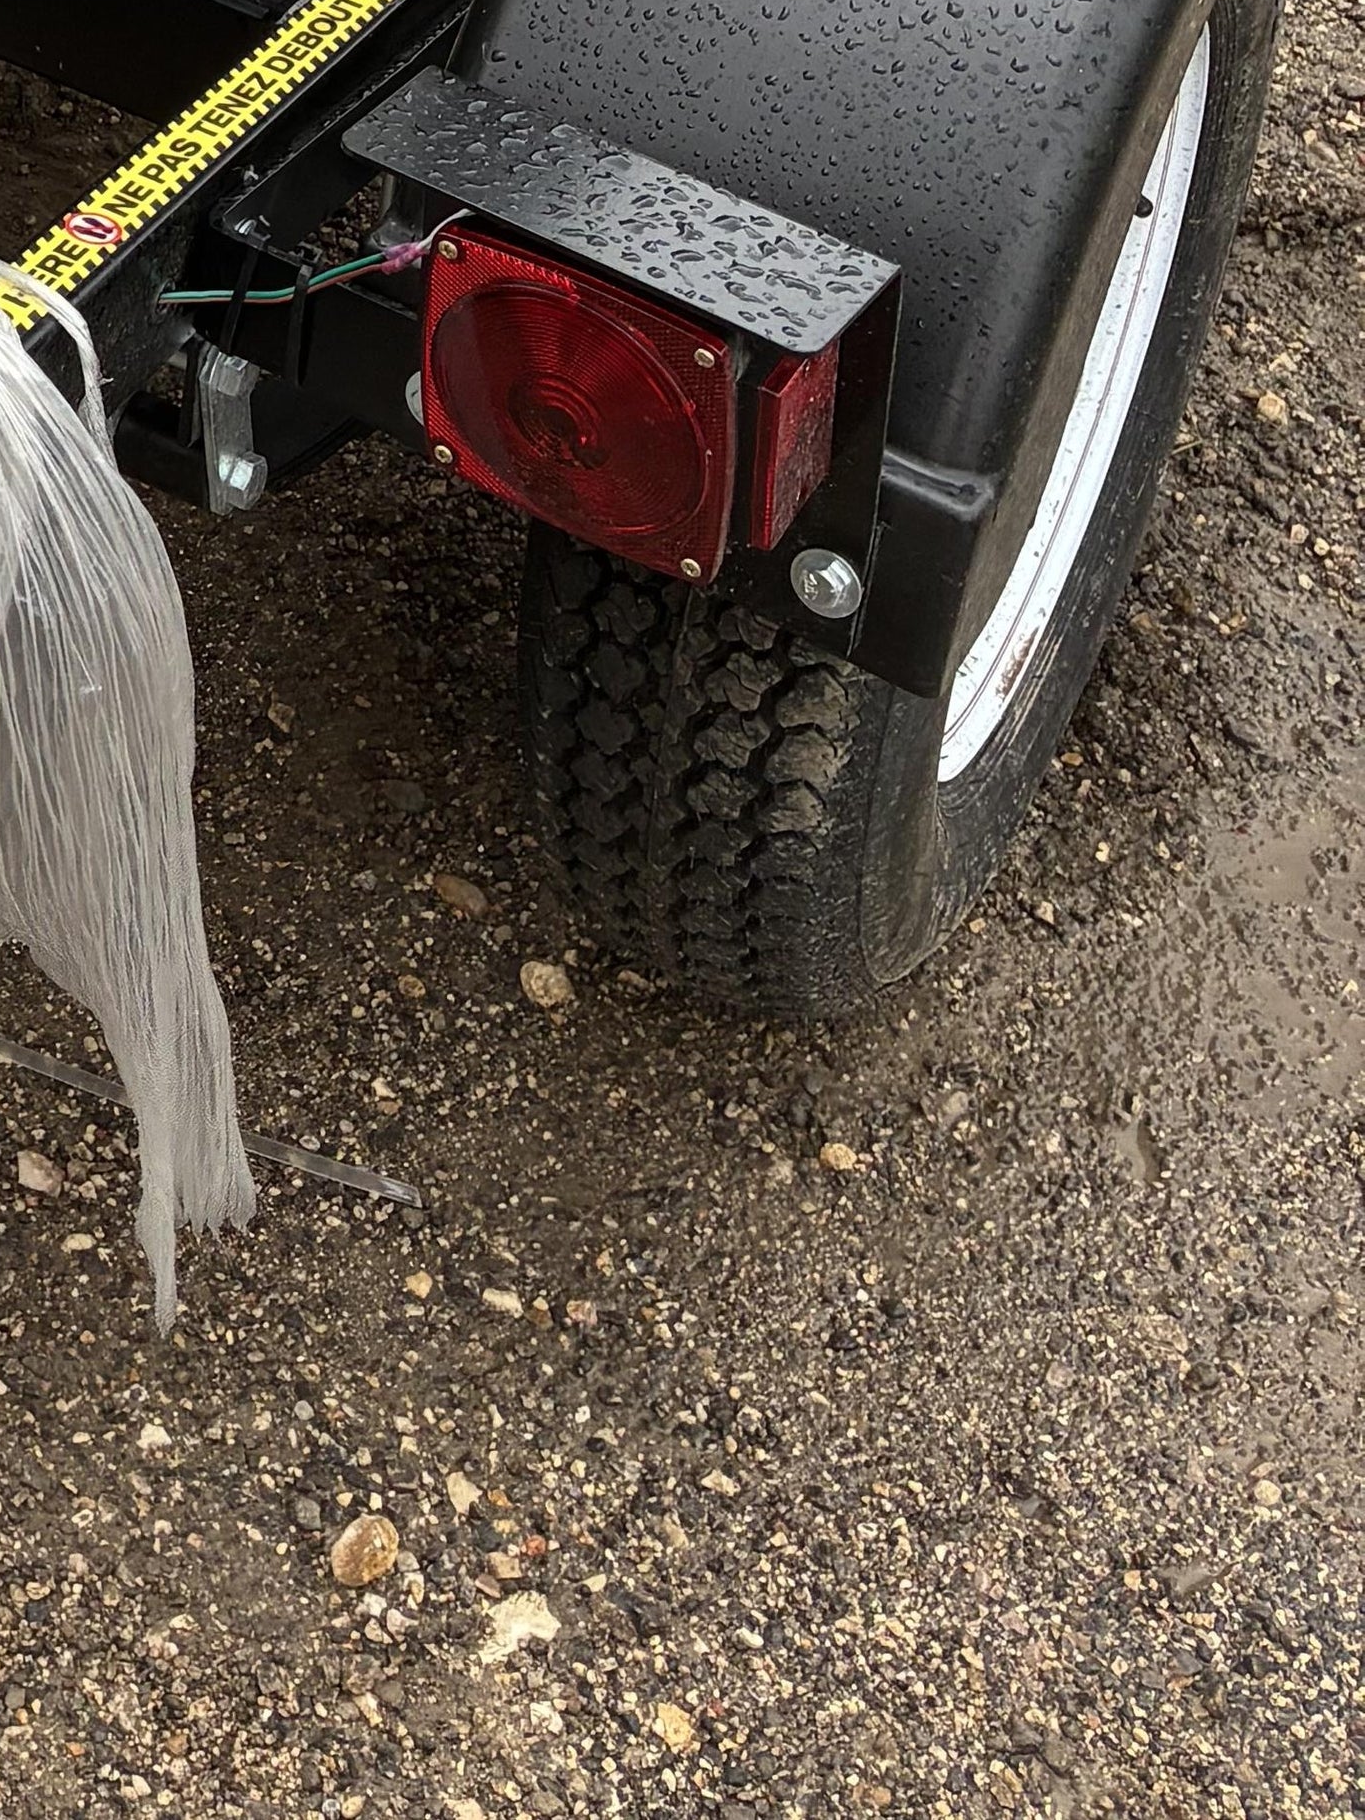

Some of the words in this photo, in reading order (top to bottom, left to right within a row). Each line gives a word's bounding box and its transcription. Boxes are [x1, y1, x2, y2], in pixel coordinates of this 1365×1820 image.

[102, 180, 154, 218] NE
[147, 138, 203, 185] PAS
[189, 71, 278, 138] TENEZ
